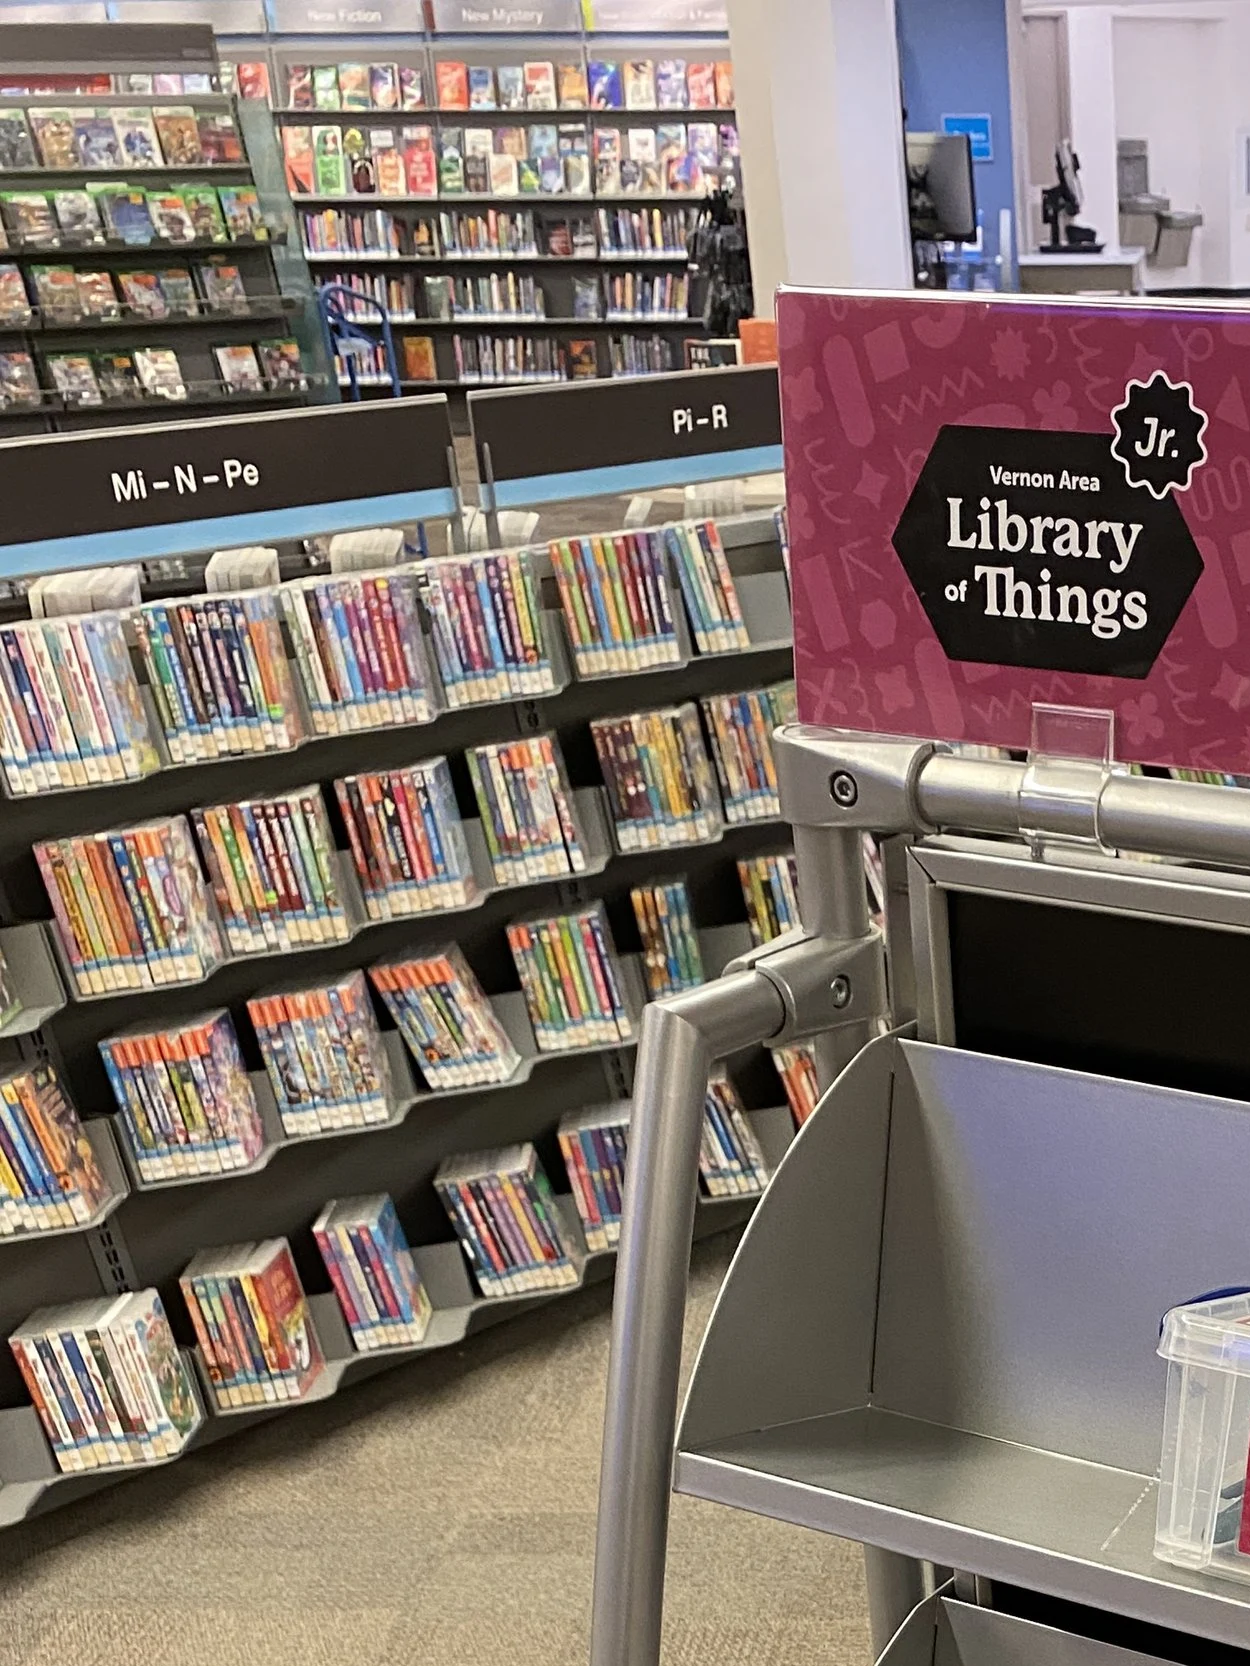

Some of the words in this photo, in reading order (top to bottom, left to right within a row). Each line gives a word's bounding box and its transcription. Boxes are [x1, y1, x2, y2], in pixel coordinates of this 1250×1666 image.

[338, 8, 382, 23] Fiction
[461, 8, 490, 23] New
[492, 8, 544, 26] Mystery
[672, 408, 693, 434] Pi
[711, 404, 728, 429] R
[1134, 417, 1179, 459] Jr.
[110, 470, 146, 502] Mi
[174, 464, 198, 494] N
[223, 459, 260, 488] Pe
[989, 464, 1055, 490] Vernon
[1059, 467, 1101, 493] Area
[945, 497, 1143, 574] Library
[944, 581, 968, 603] of
[974, 564, 1149, 640] Things
